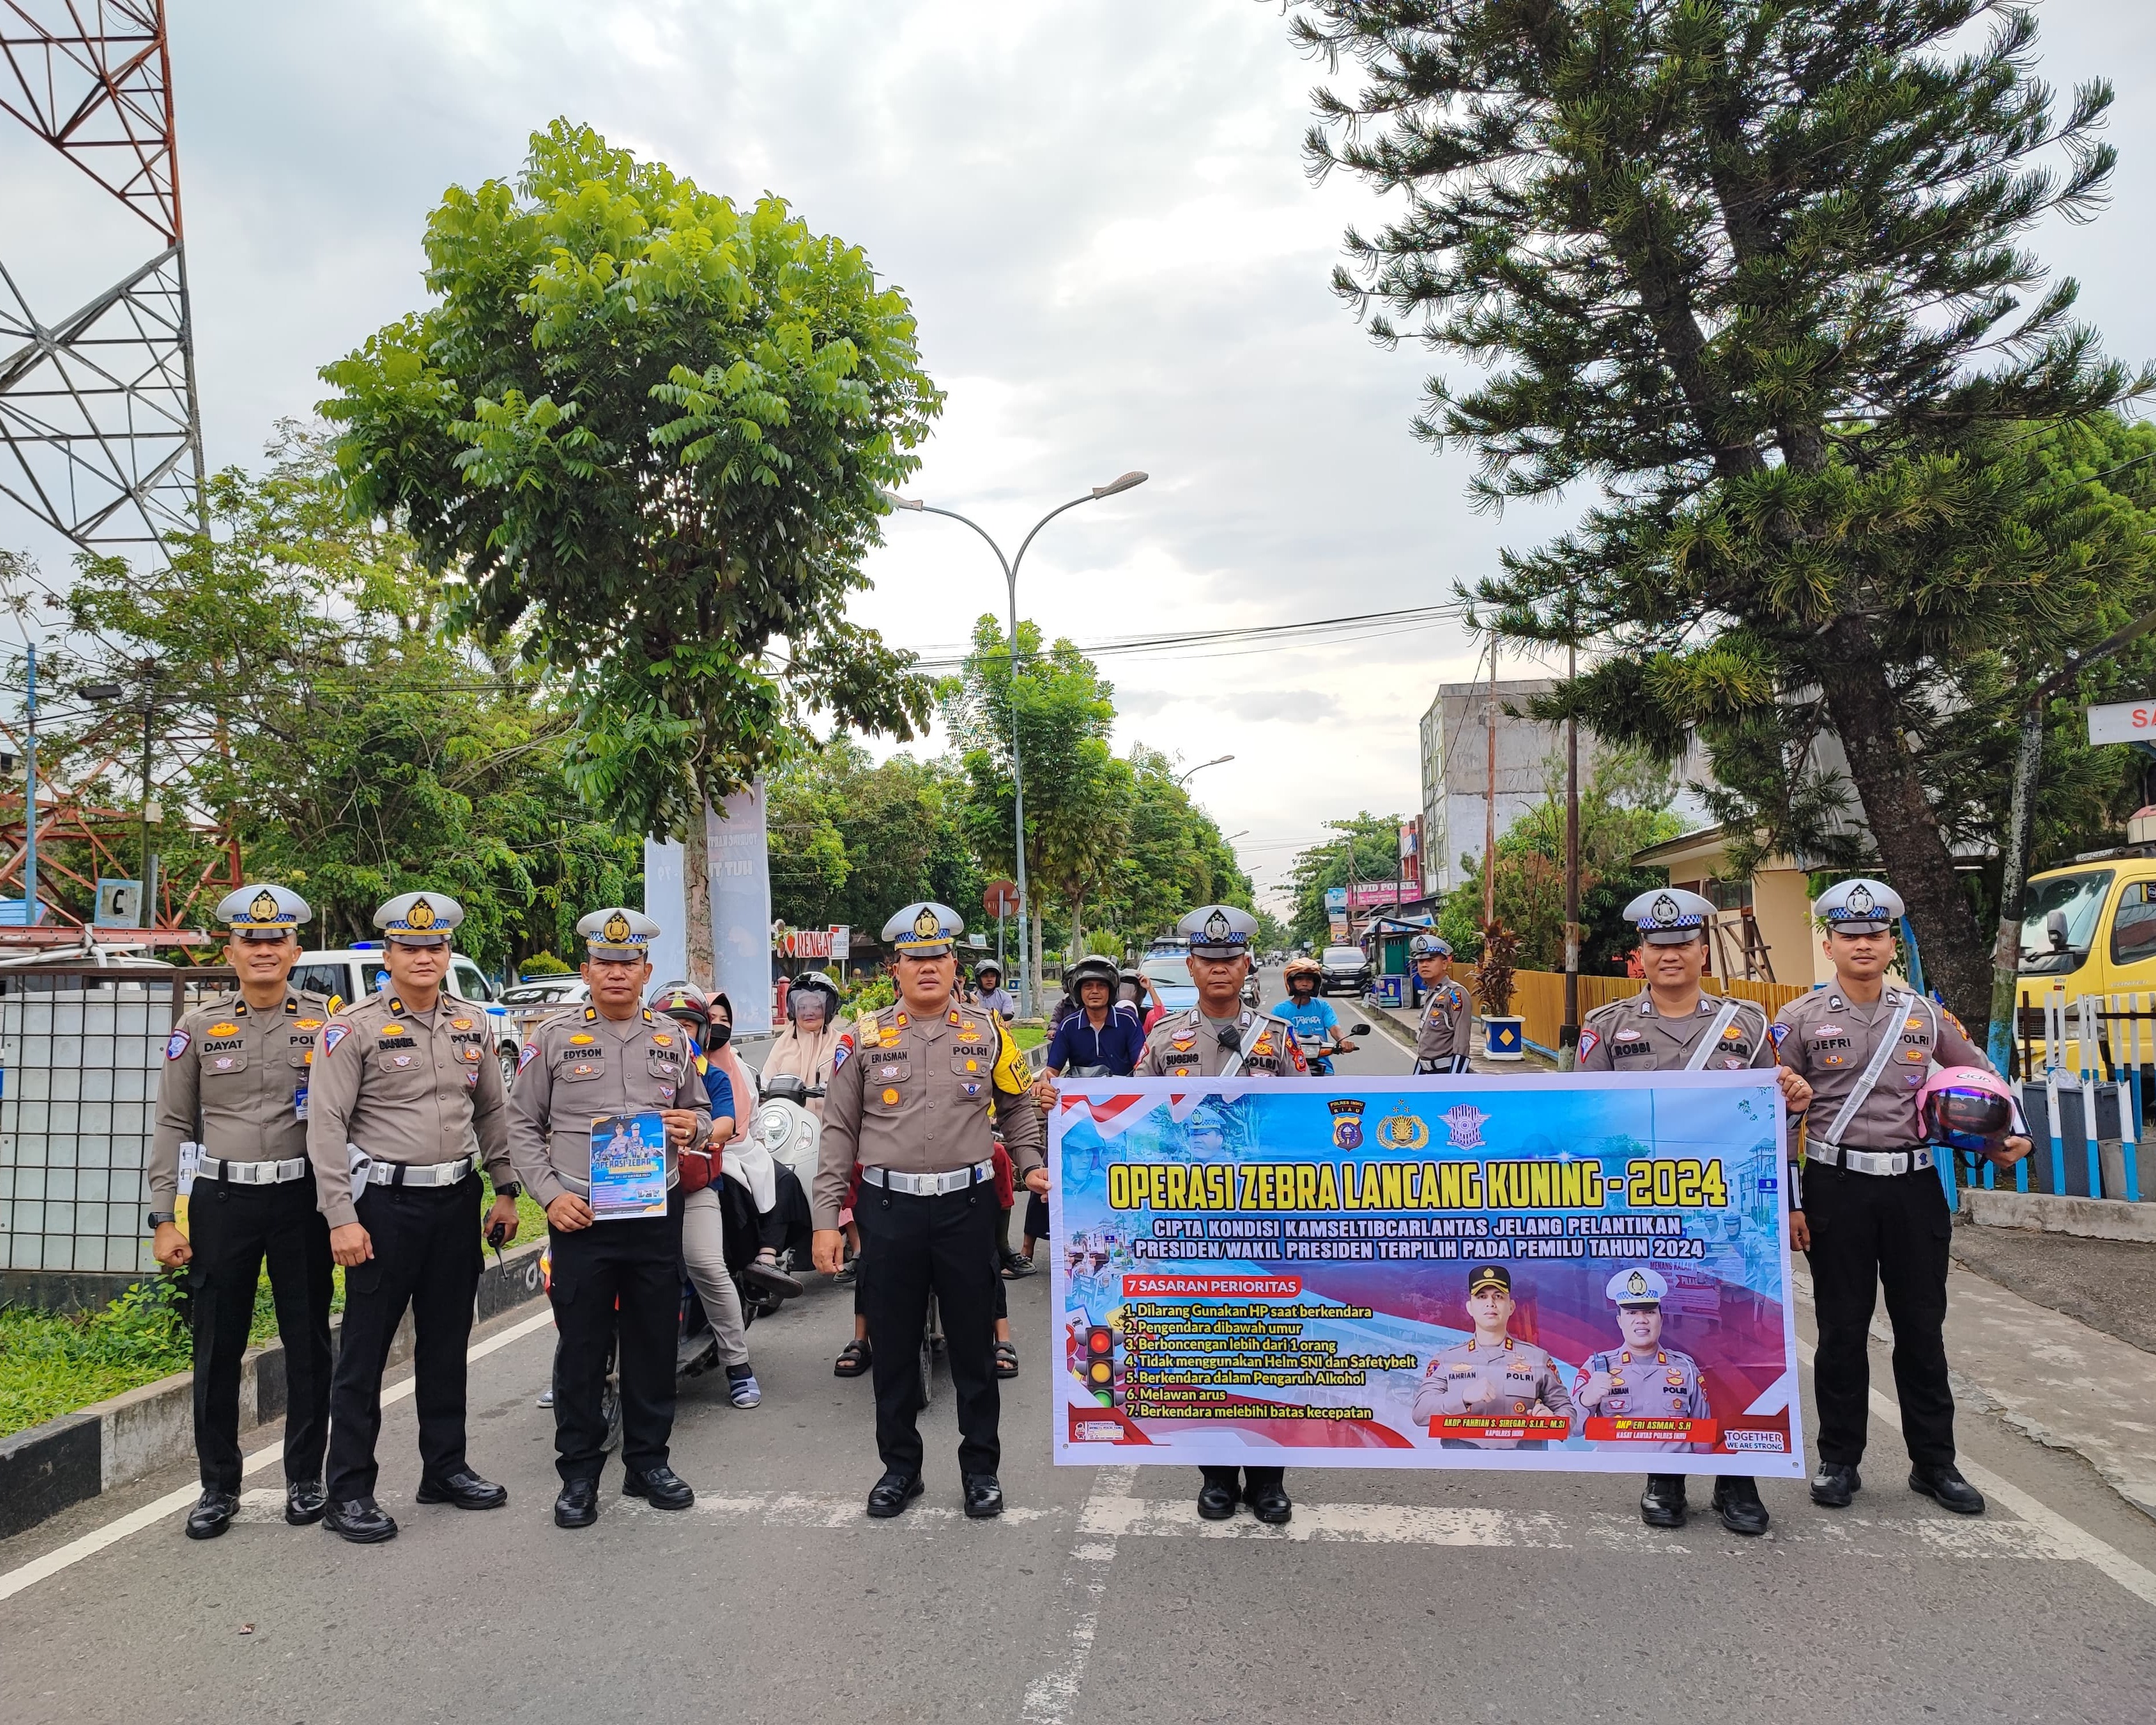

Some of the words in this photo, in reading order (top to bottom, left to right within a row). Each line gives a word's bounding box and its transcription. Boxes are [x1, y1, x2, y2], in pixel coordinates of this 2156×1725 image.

[113, 890, 124, 914] C
[797, 933, 834, 956] RENGAT
[204, 1040, 244, 1052] DAYAT
[290, 1036, 315, 1045] POL
[1813, 1038, 1851, 1051] JEFRI
[563, 1048, 601, 1060] EDYSON
[650, 1049, 678, 1062] POLRI
[953, 1045, 987, 1056] POLRI
[1615, 1042, 1650, 1056] ROBBI
[872, 1054, 881, 1064] ERI
[883, 1051, 907, 1062] ASMAN
[1110, 1166, 1234, 1209] OPERASI
[1240, 1165, 1339, 1209] ZEBRA
[1342, 1163, 1482, 1209] LANCANG
[1488, 1162, 1603, 1207] KUNING
[1628, 1160, 1726, 1206] 2024
[1154, 1220, 1203, 1237] CIPTA
[1209, 1220, 1279, 1237] KONDISI
[1285, 1218, 1487, 1237] KAMSELTIBCARLANTAS
[1493, 1218, 1562, 1236] JELANG
[1568, 1217, 1681, 1235] PELANTIKAN
[1135, 1240, 1280, 1259] PRESIDEN/WAKIL
[1287, 1241, 1372, 1259] PRESIDEN
[1378, 1241, 1457, 1259] TERPILIH
[1462, 1240, 1510, 1258] PADA
[1516, 1240, 1584, 1258] PEMILU
[1589, 1239, 1648, 1257] TAHUN
[1654, 1240, 1704, 1258] 2024
[1127, 1280, 1136, 1291] 7
[1139, 1280, 1208, 1292] SASARAN
[1211, 1281, 1296, 1293] PERIORITAS
[1125, 1305, 1135, 1316] 1.
[1138, 1304, 1190, 1318] Dilarang
[1192, 1305, 1247, 1317] Gunakan
[1250, 1305, 1268, 1317] HP
[1271, 1308, 1297, 1317] saat
[1300, 1305, 1372, 1318] berkendara
[1125, 1322, 1135, 1333] 2.
[1139, 1321, 1211, 1336] Pengendara
[1214, 1321, 1265, 1333] dibawah
[1269, 1324, 1302, 1334] umur
[1125, 1339, 1136, 1350] 3.
[1140, 1338, 1227, 1352] Berboncengan
[1230, 1339, 1260, 1350] lebih
[1263, 1339, 1287, 1351] dari
[1290, 1340, 1298, 1351] 1
[1300, 1341, 1337, 1354] orang
[1126, 1356, 1137, 1367] 4.
[1140, 1355, 1173, 1367] Tidak
[1176, 1355, 1263, 1369] menggunakan
[1265, 1355, 1298, 1367] Helm
[1300, 1356, 1322, 1368] SNI
[1325, 1356, 1348, 1368] dan
[1351, 1355, 1417, 1371] Safetybelt
[1126, 1372, 1137, 1383] 5.
[1140, 1371, 1211, 1383] Berkendara
[1214, 1371, 1251, 1384] dalam
[1254, 1372, 1313, 1386] Pengaruh
[1315, 1372, 1365, 1385] Alkohol
[1448, 1372, 1476, 1381] FAHRIAN
[1506, 1373, 1534, 1382] POLRI
[1126, 1389, 1138, 1400] 6.
[1140, 1388, 1196, 1400] Melawan
[1199, 1390, 1226, 1401] arus
[1663, 1386, 1687, 1395] POLRI
[1127, 1405, 1138, 1416] 7.
[1141, 1405, 1212, 1417] Berkendara
[1215, 1405, 1268, 1418] melebihi
[1270, 1405, 1305, 1418] batas
[1307, 1406, 1372, 1420] kecepatan
[1462, 1419, 1489, 1428] FAHRIAN
[1491, 1419, 1497, 1427] S.
[1616, 1420, 1632, 1429] AKP
[1632, 1421, 1645, 1429] ERI
[1678, 1422, 1691, 1431] S.H
[1727, 1431, 1782, 1443] TOGETHER
